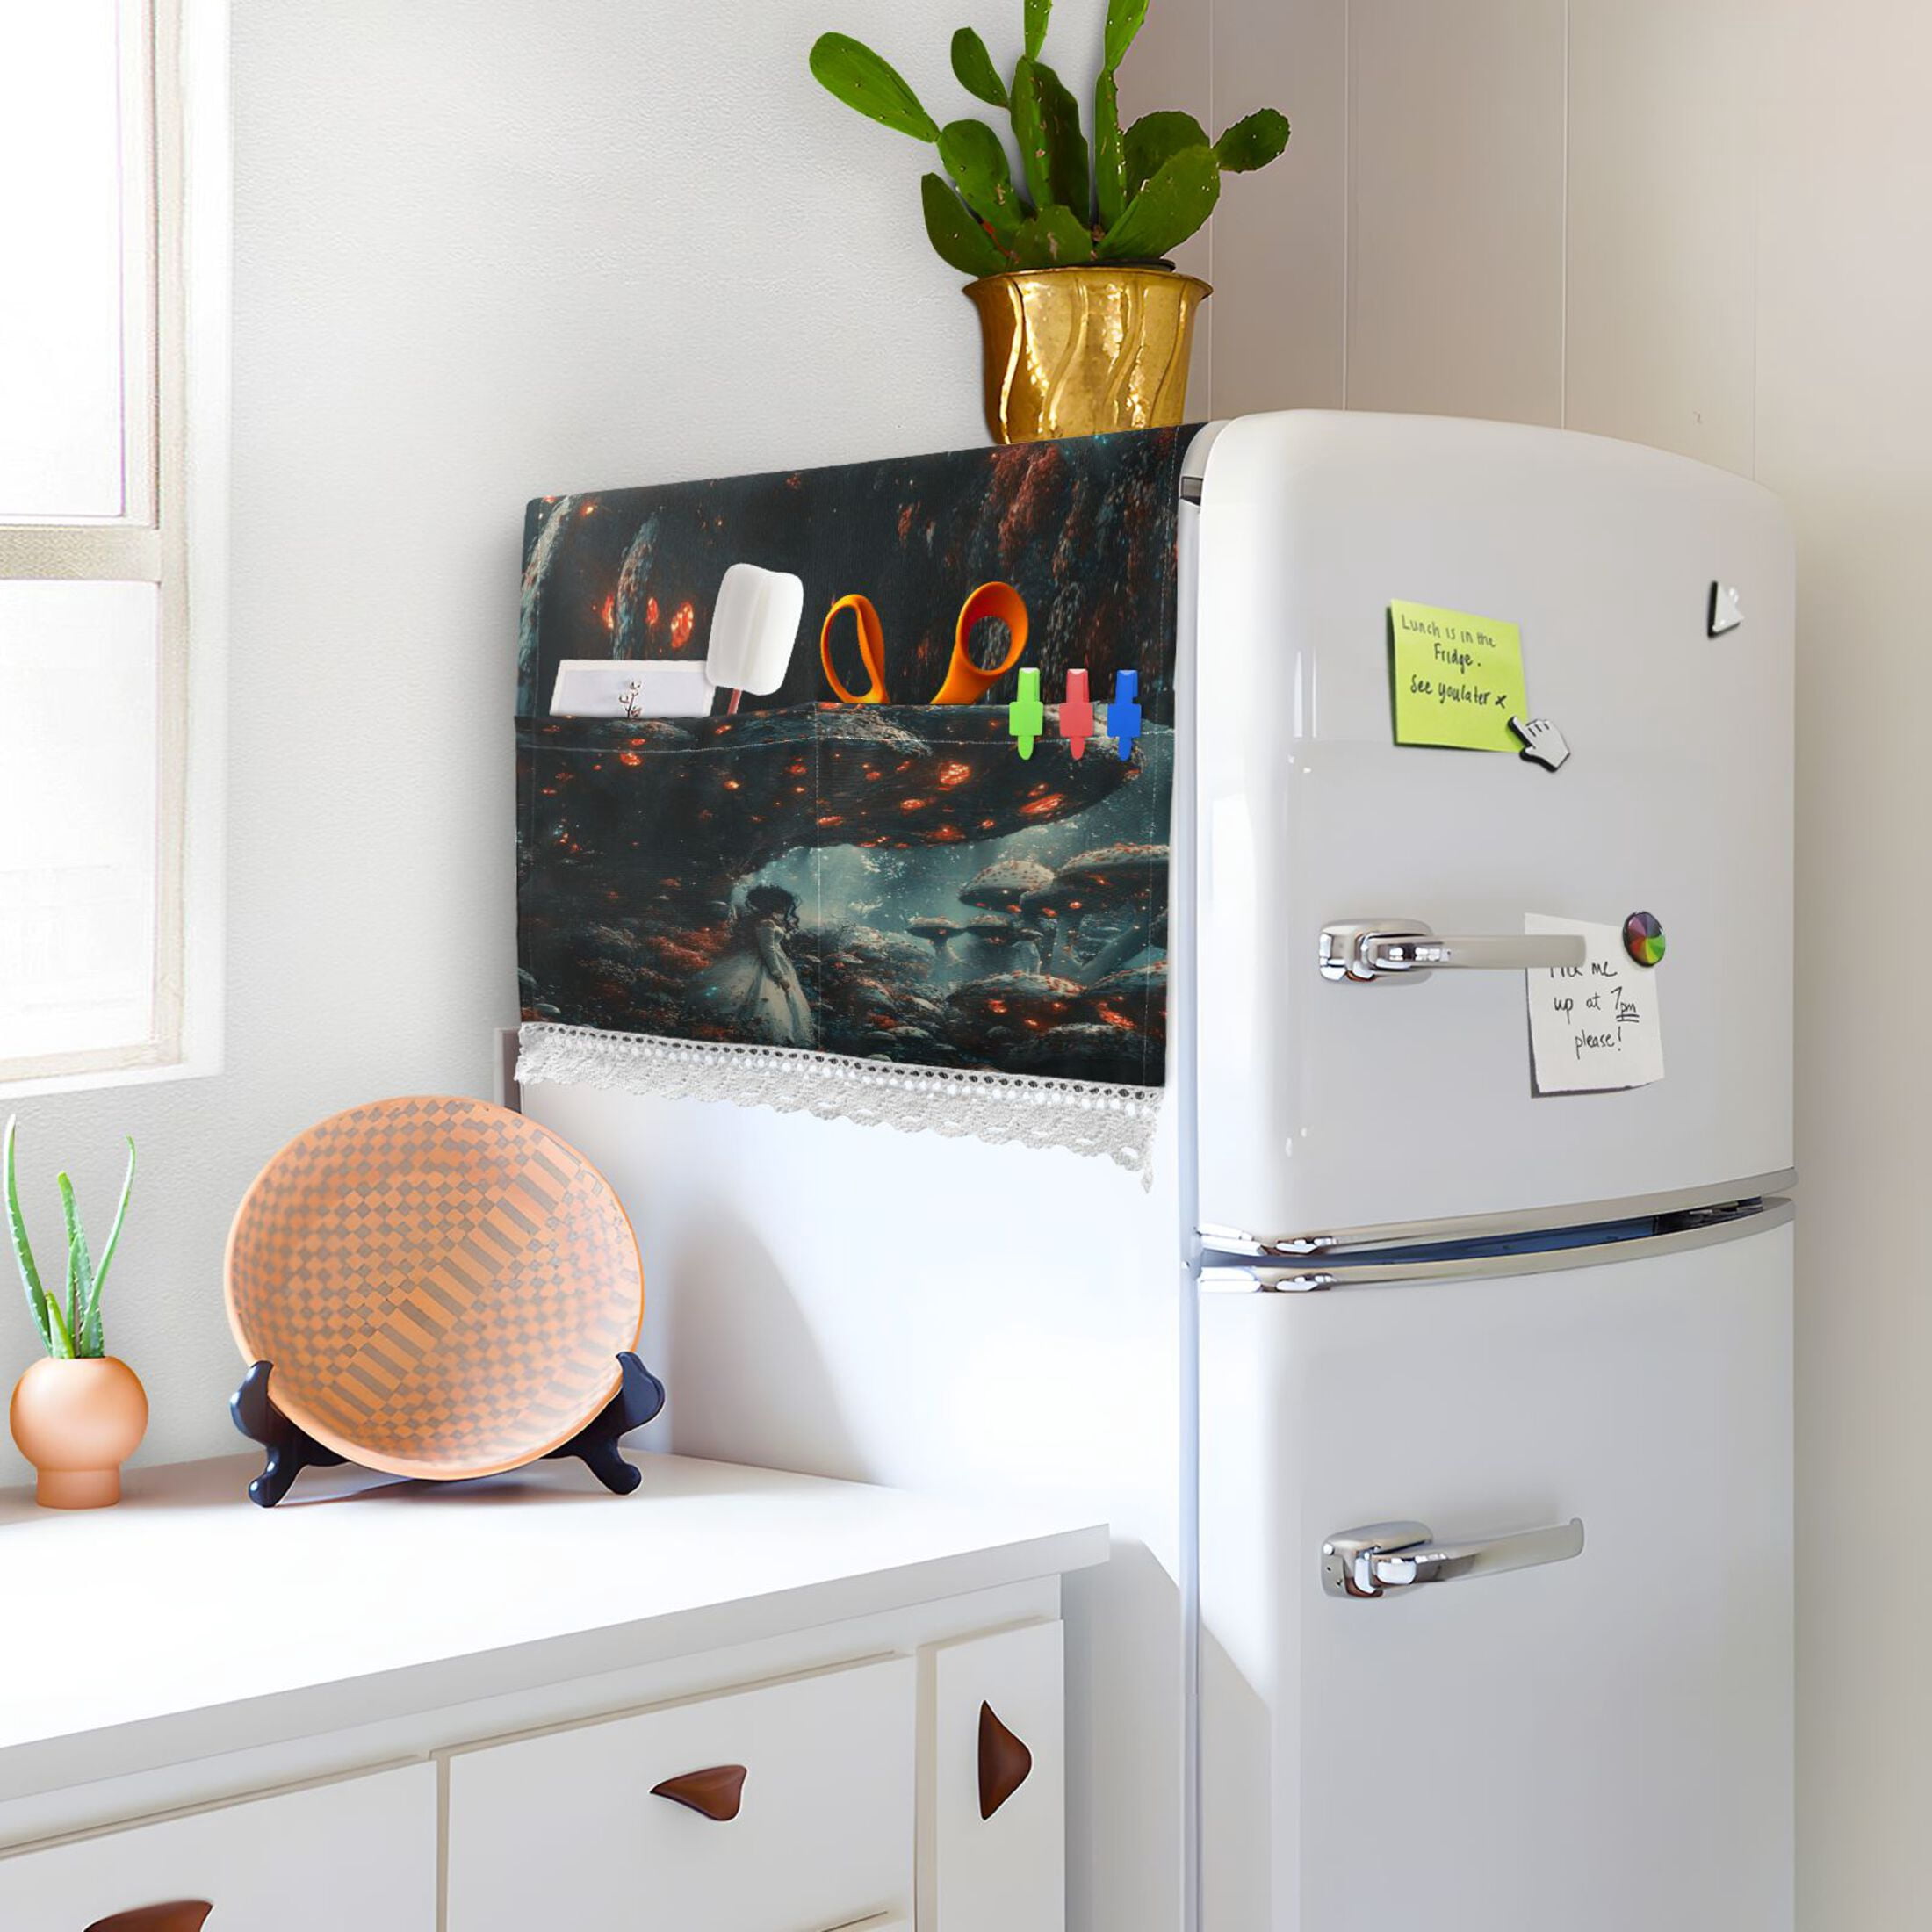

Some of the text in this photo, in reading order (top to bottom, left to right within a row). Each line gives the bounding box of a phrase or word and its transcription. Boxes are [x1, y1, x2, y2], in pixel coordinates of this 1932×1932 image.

[1402, 614, 1441, 638] Lunch
[1476, 632, 1496, 648] the
[1409, 674, 1433, 695] See
[1591, 961, 1618, 977] me
[1554, 997, 1574, 1025] up
[1586, 992, 1601, 1011] at
[1575, 1026, 1622, 1060] please!
